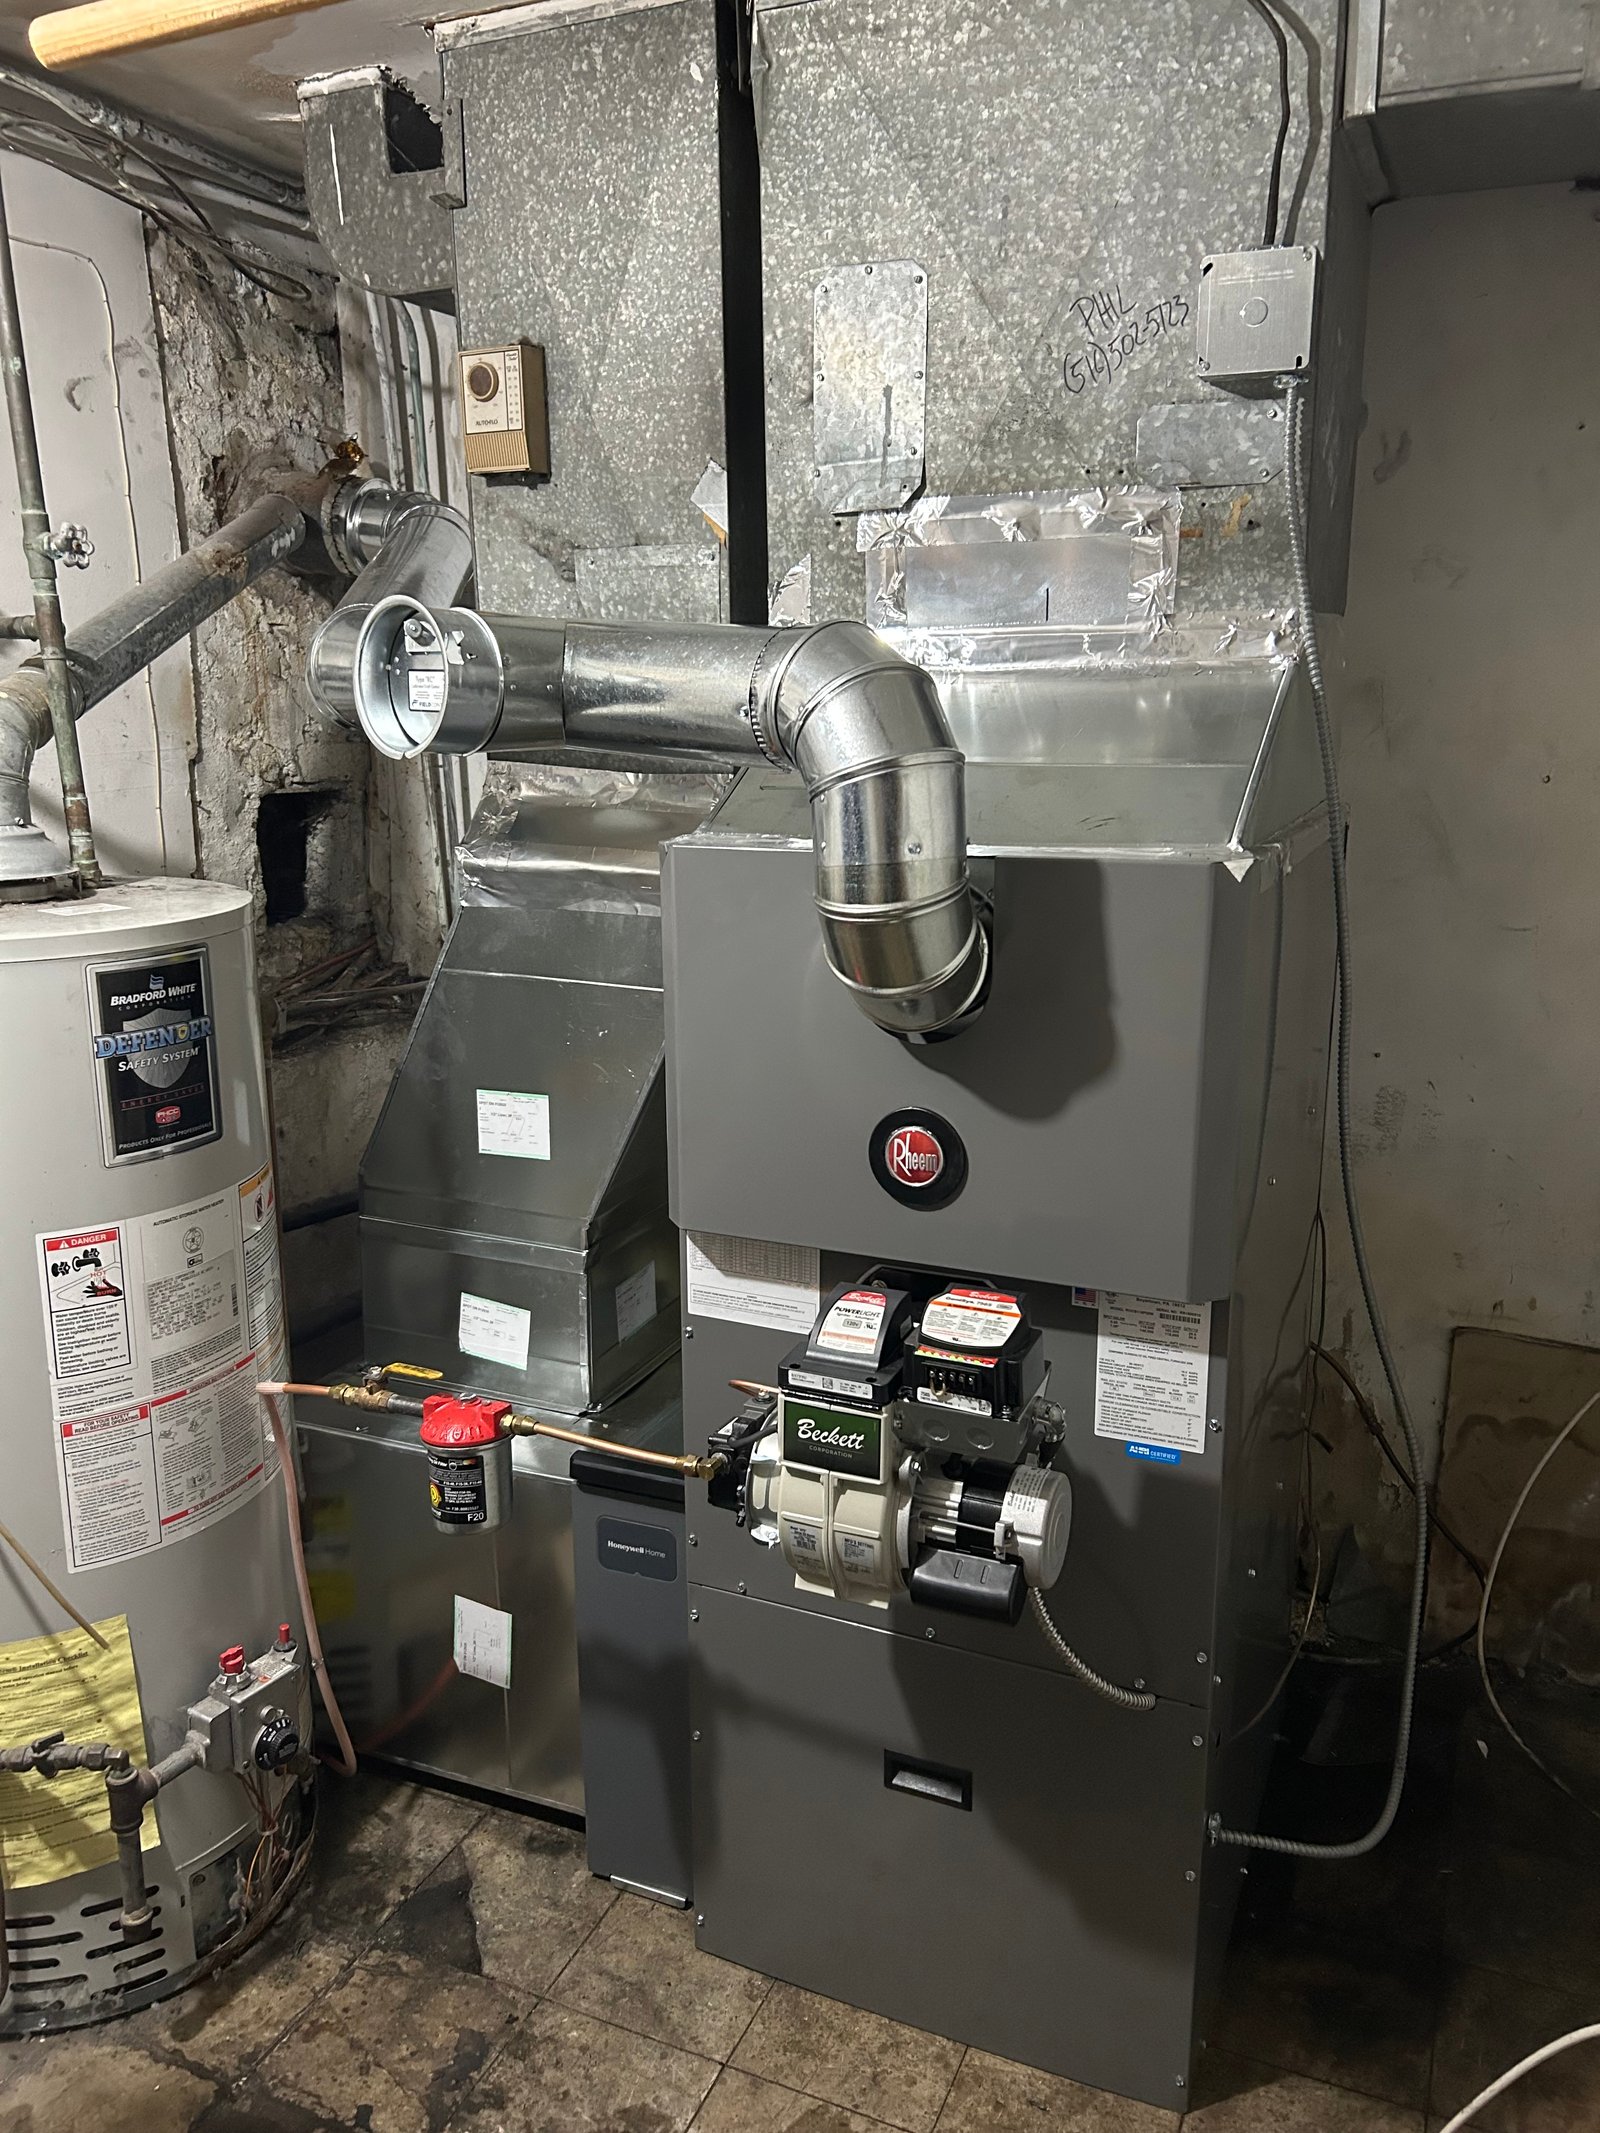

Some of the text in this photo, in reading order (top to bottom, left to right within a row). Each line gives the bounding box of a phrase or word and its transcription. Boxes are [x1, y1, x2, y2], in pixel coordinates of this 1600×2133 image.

[1069, 284, 1138, 337] PHIL
[110, 983, 196, 1006] BRADFORD WHITE
[118, 994, 191, 1011] CORPORATION
[94, 1016, 212, 1059] DEFENDER
[118, 1047, 199, 1072] SAFETY SYSTEM
[118, 1138, 149, 1150] PRODUCTS
[150, 1135, 165, 1143] ONLY
[893, 1132, 938, 1177] Rheem
[71, 1233, 107, 1246] DANGER
[90, 1270, 107, 1278] HOT
[834, 1305, 881, 1318] POWERLIGHT
[90, 1421, 110, 1431] BEFORE
[111, 1415, 139, 1426] OPERATING
[95, 1417, 110, 1425] YOUR
[111, 1413, 129, 1421] SAFETY
[797, 1418, 865, 1450] Beckett
[808, 1444, 853, 1458] CORPORATION
[1150, 1450, 1176, 1460] CERTIFIED
[467, 1512, 484, 1522] F20
[607, 1540, 666, 1559] Honeywell Home
[20, 1660, 57, 1672] Installation
[58, 1652, 88, 1663] Checklist
